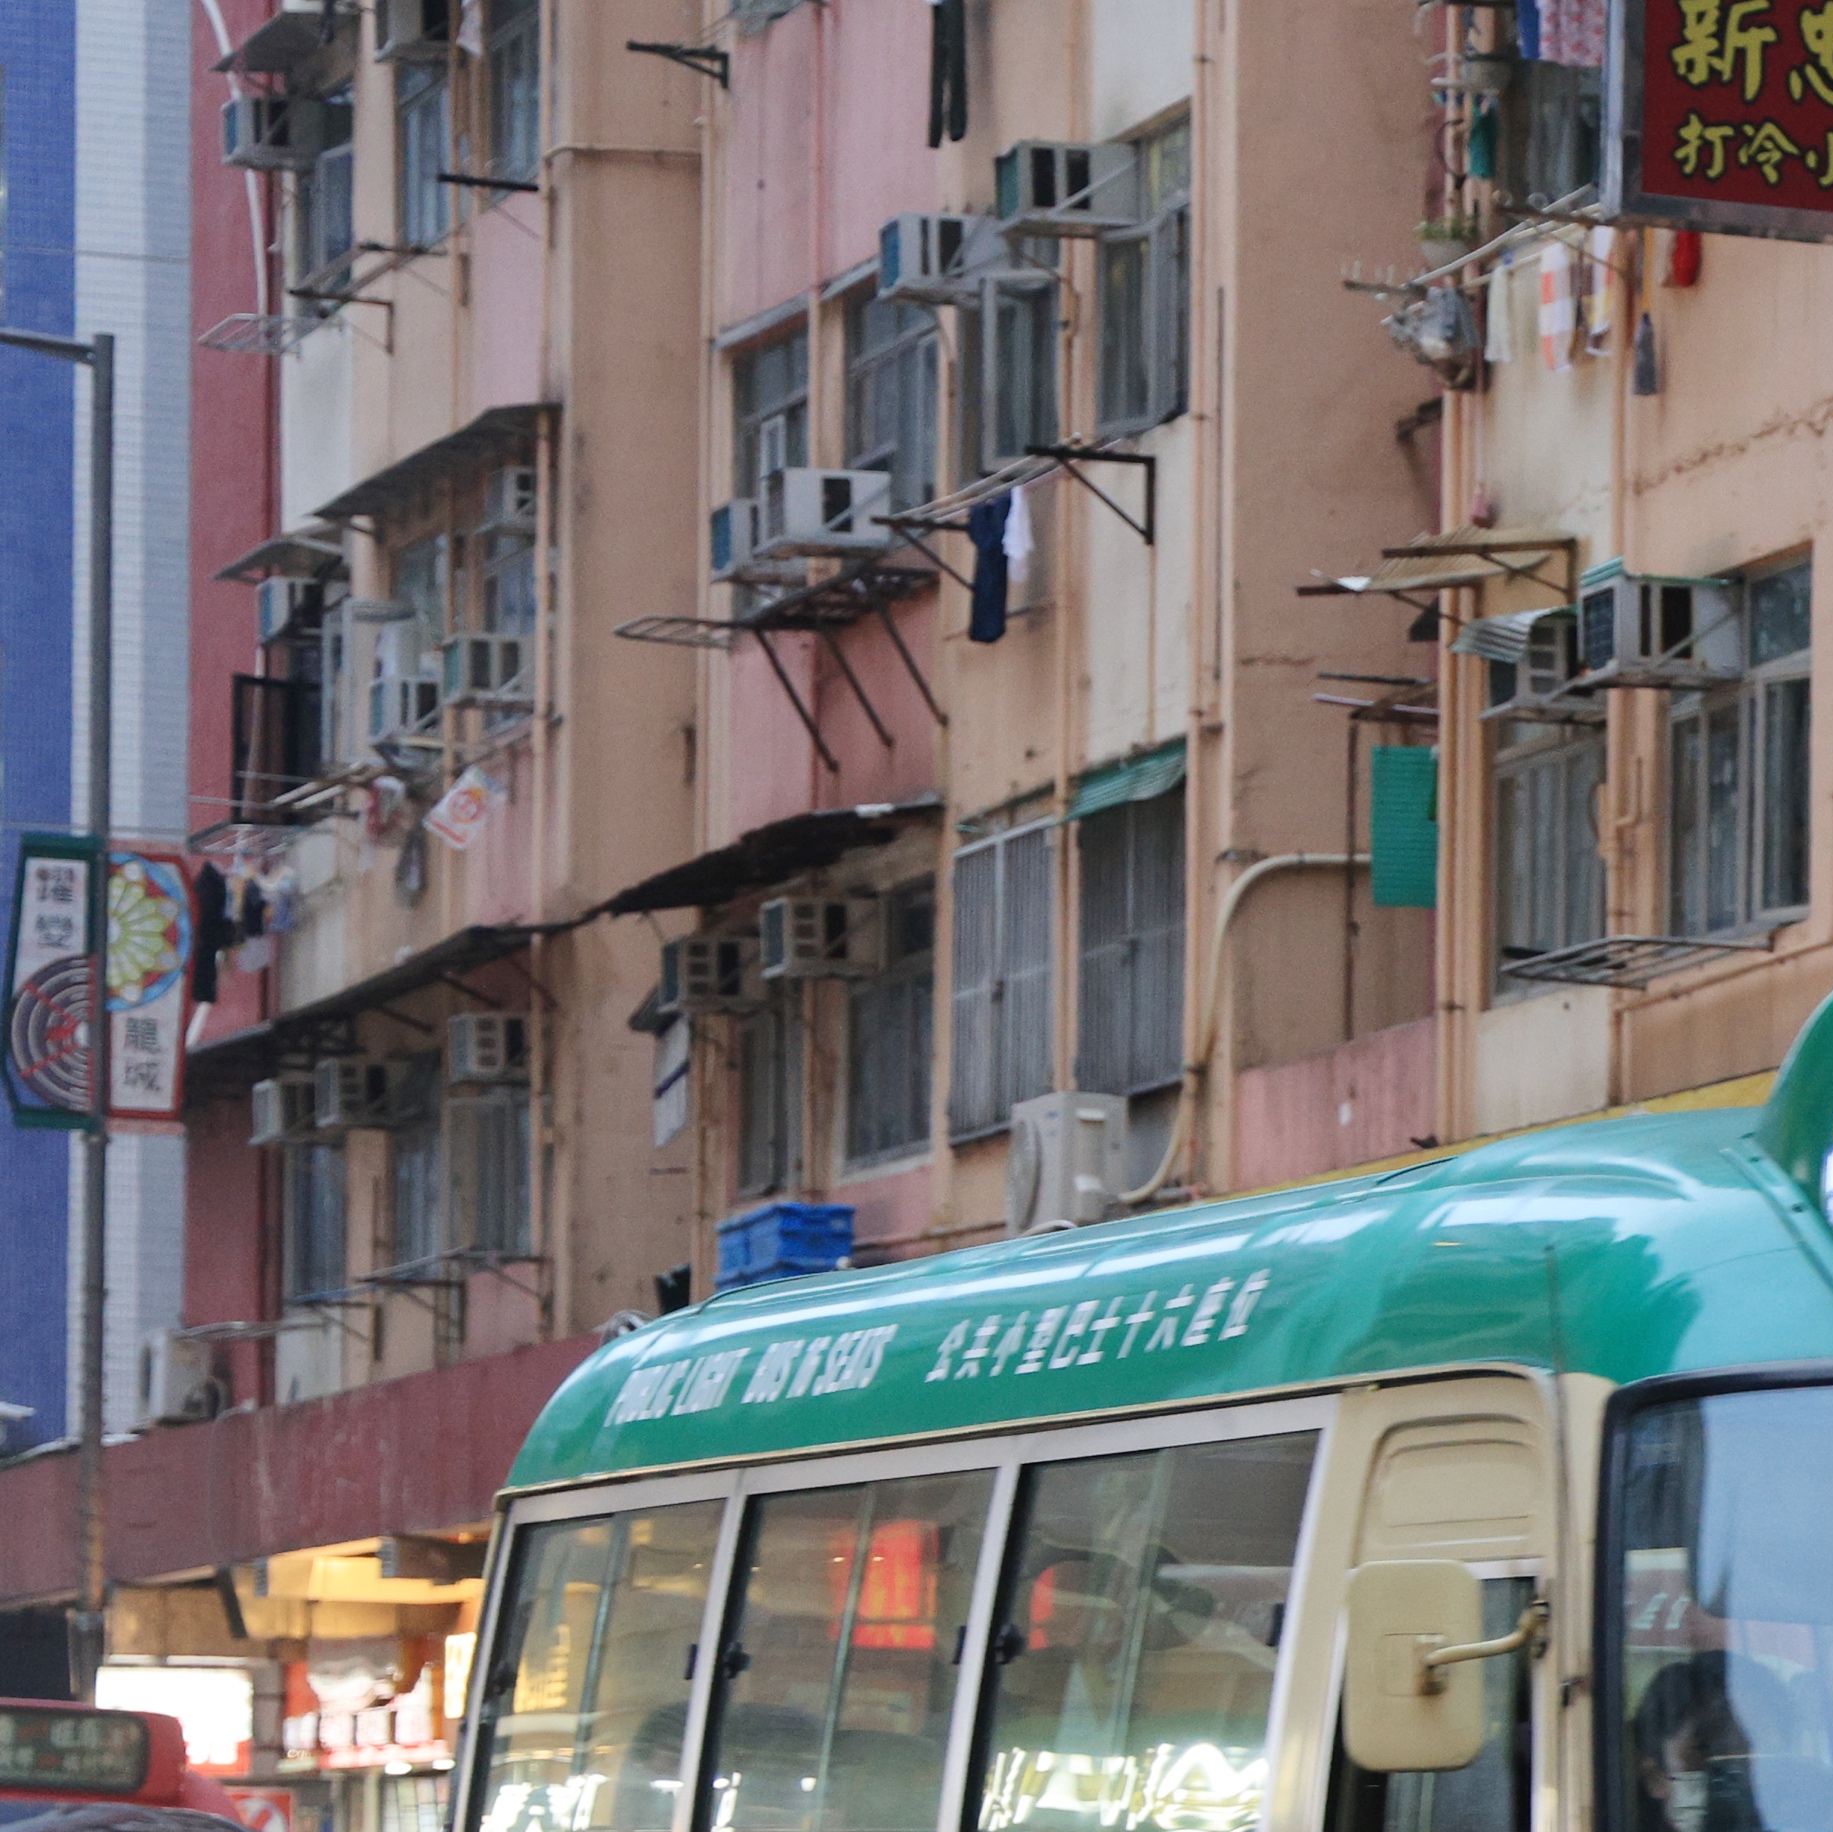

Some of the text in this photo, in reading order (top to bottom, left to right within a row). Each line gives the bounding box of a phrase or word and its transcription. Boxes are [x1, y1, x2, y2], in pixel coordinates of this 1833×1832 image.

[925, 1268, 1273, 1384] 公共小型巴士十六座位
[741, 1339, 806, 1405] BUS
